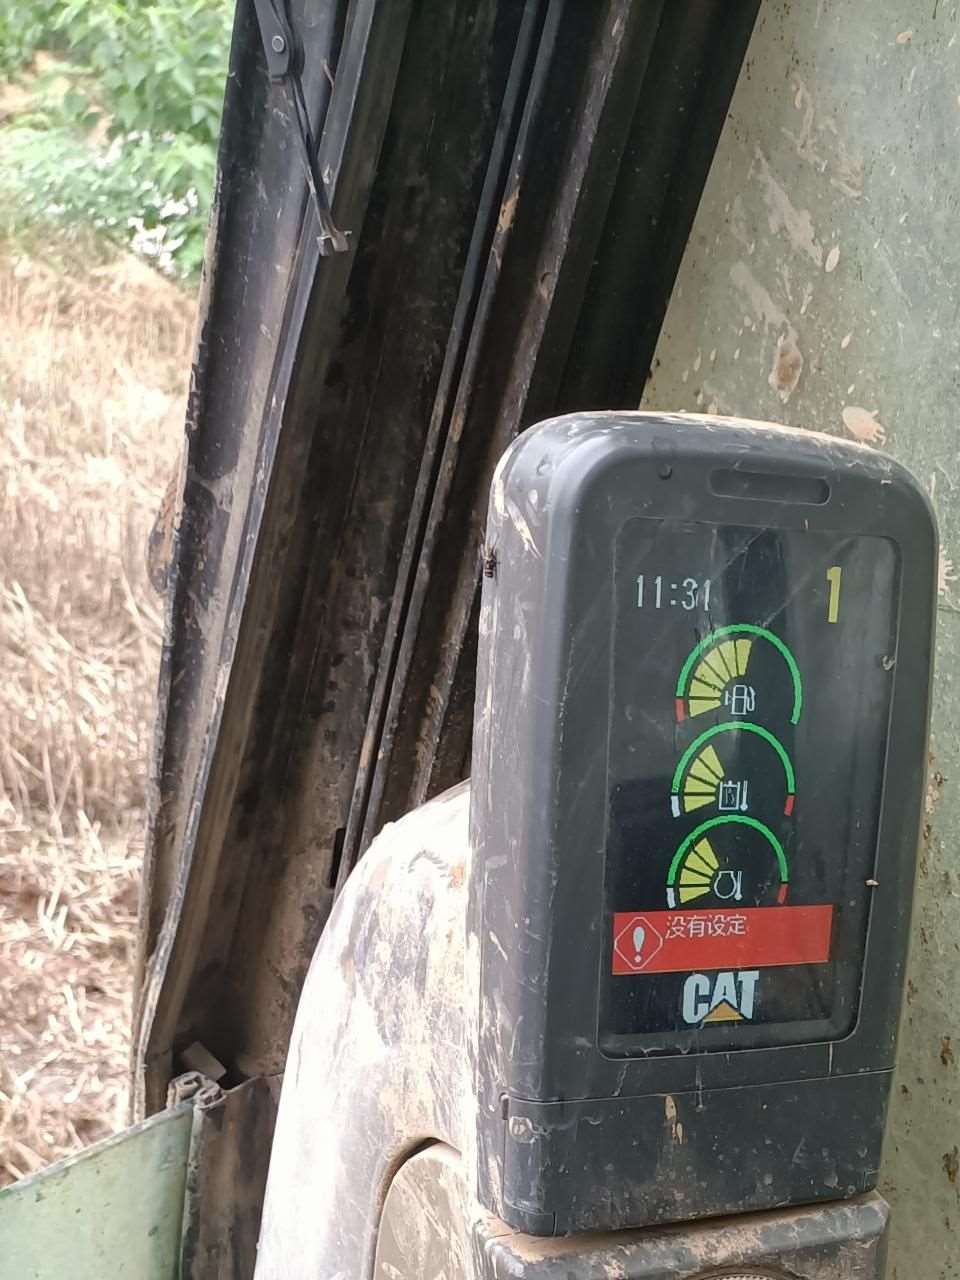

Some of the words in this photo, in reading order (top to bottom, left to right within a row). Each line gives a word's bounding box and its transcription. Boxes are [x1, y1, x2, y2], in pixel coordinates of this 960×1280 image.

[636, 574, 711, 612] 11:31
[826, 566, 842, 624] 1
[664, 913, 748, 940] 没有设定
[682, 969, 760, 1024] CAT
